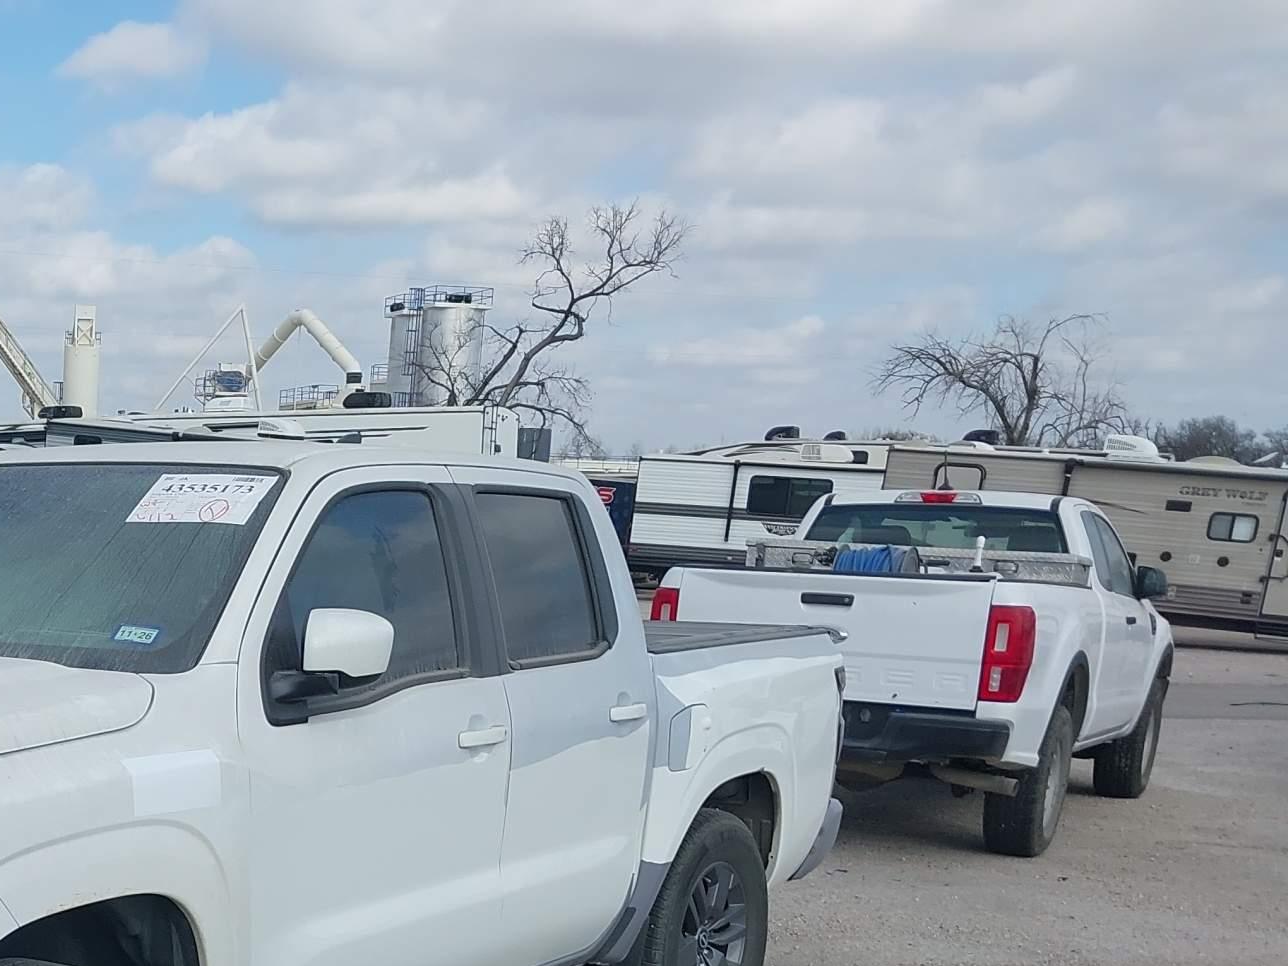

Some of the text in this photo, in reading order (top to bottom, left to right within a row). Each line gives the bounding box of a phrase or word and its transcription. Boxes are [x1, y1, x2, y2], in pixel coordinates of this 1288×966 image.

[160, 483, 255, 495] 43535173
[1178, 486, 1269, 501] GREY WOLF
